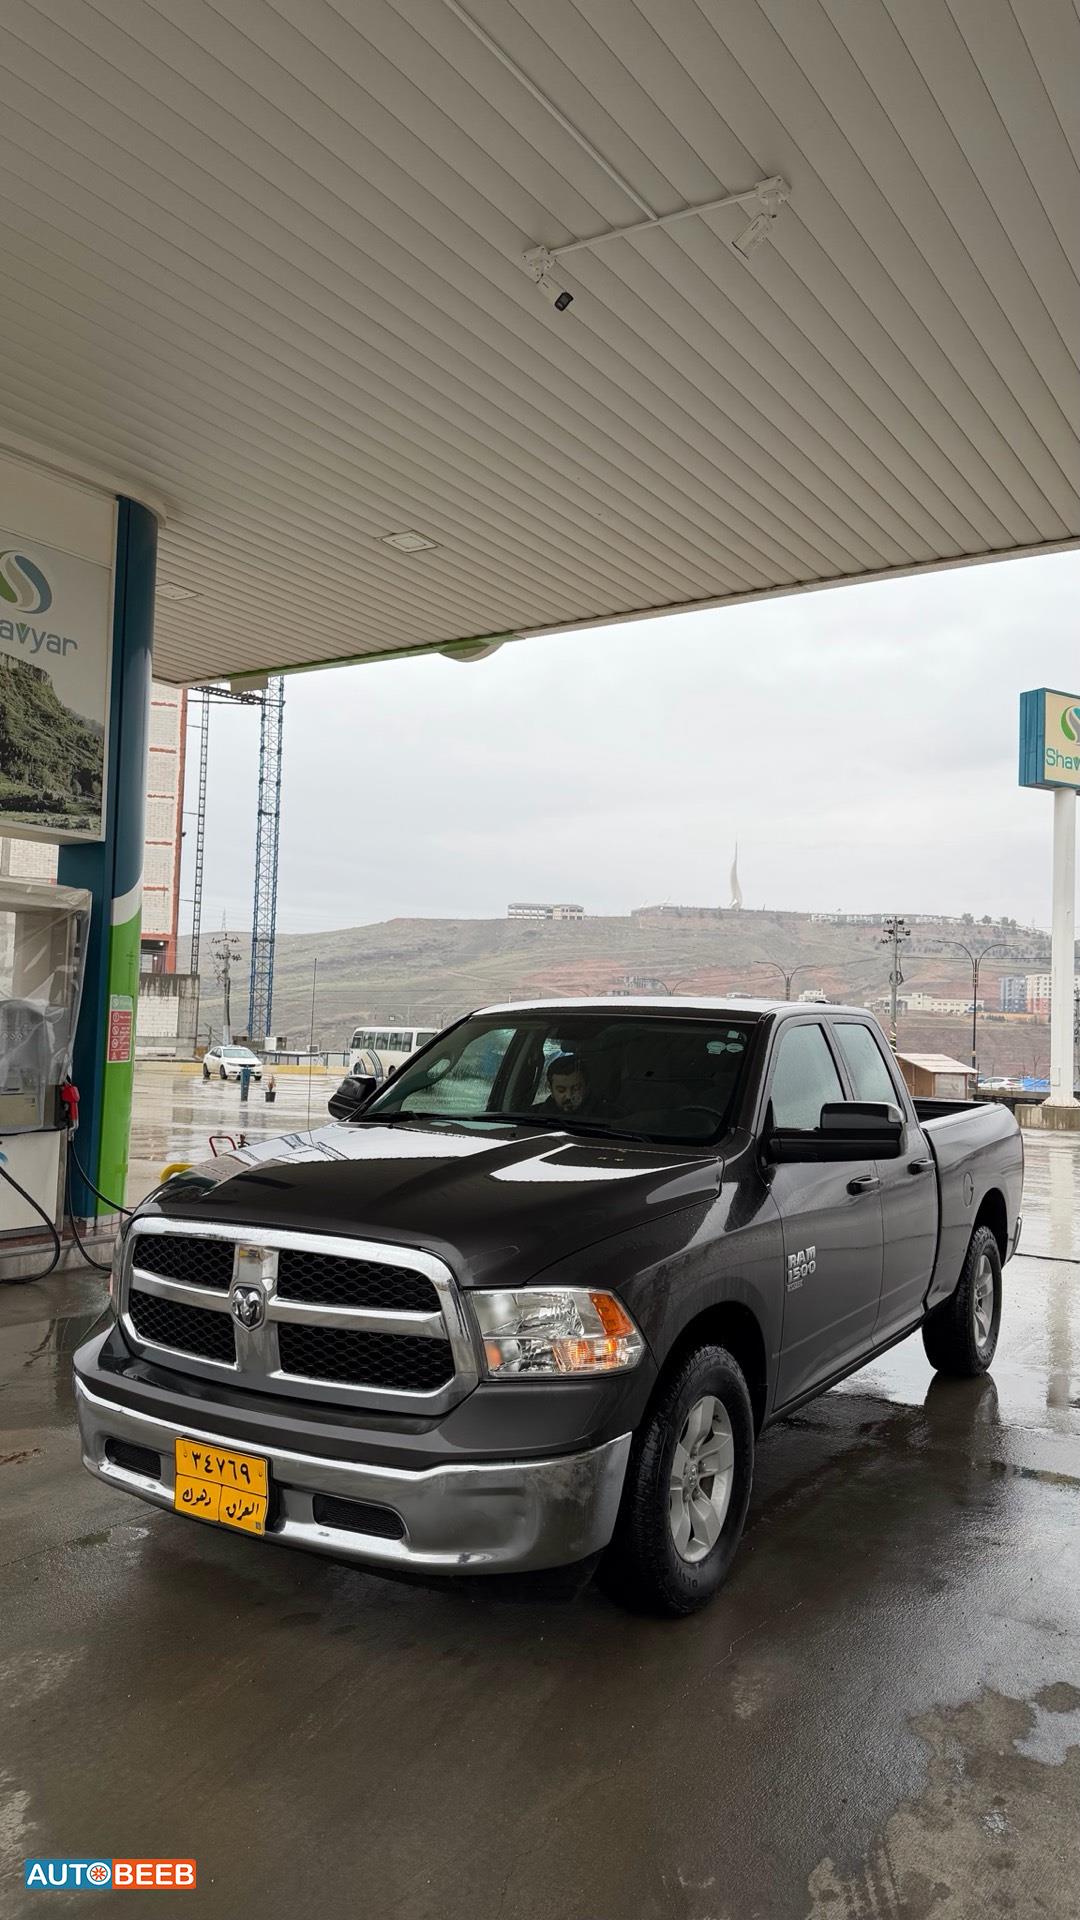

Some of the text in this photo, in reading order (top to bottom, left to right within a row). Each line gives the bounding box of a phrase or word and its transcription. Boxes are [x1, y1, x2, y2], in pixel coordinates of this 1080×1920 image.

[787, 1246, 816, 1268] RAM
[787, 1260, 816, 1283] 1500
[191, 1450, 251, 1485] ٣٤٧٦٩
[182, 1487, 212, 1506] دهوك
